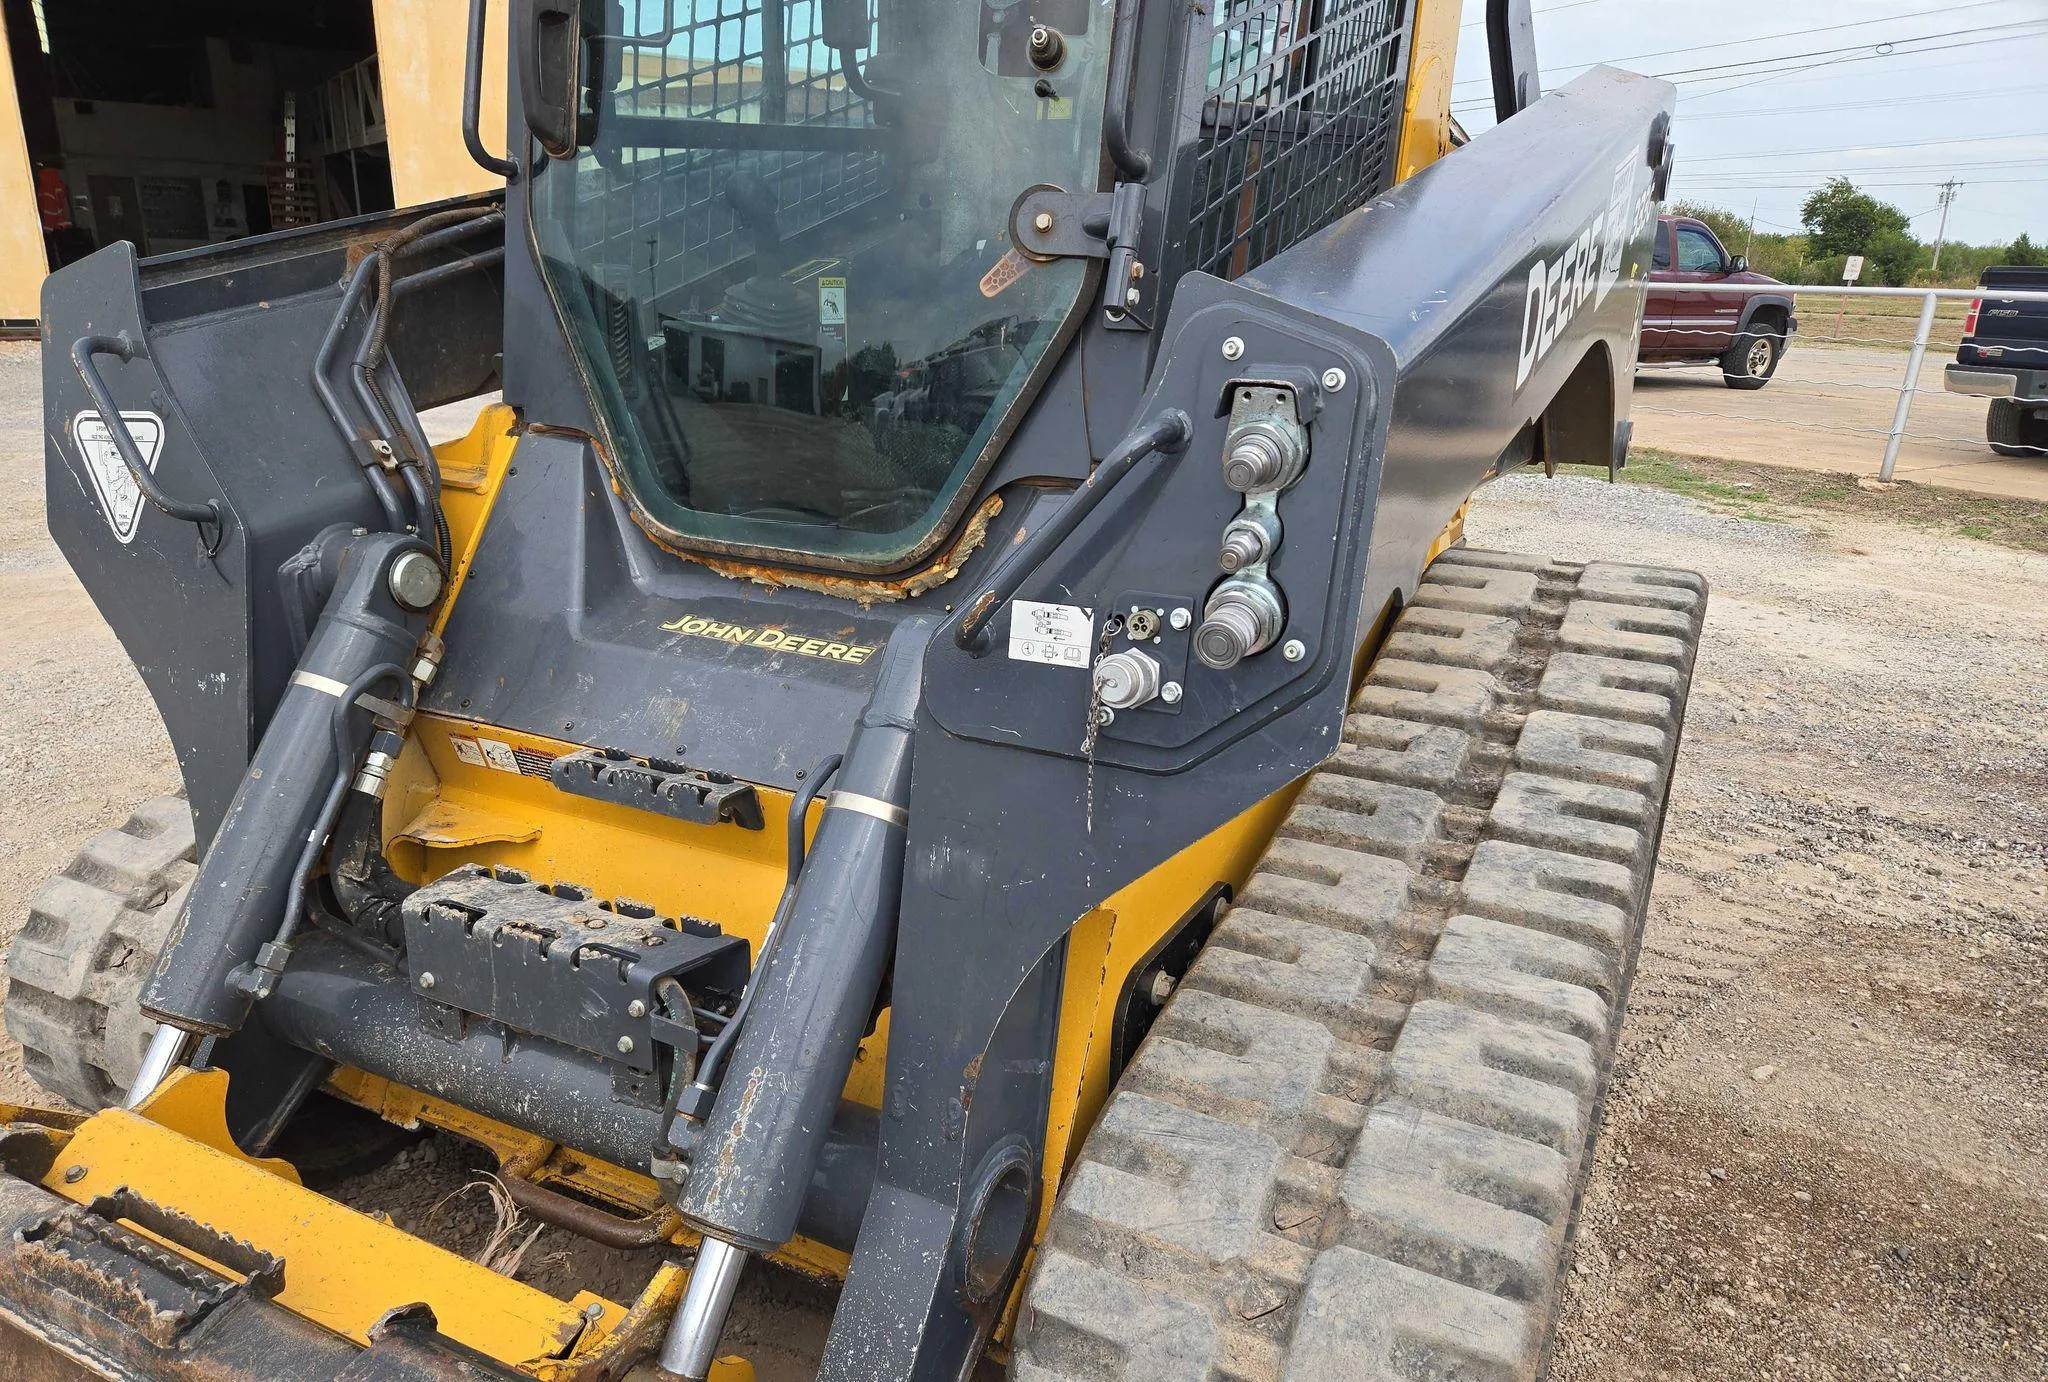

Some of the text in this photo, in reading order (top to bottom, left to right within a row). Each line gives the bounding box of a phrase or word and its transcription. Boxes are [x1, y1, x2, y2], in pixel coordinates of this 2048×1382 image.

[1516, 211, 1604, 391] DEERE
[661, 615, 877, 663] JOHN DEERE
